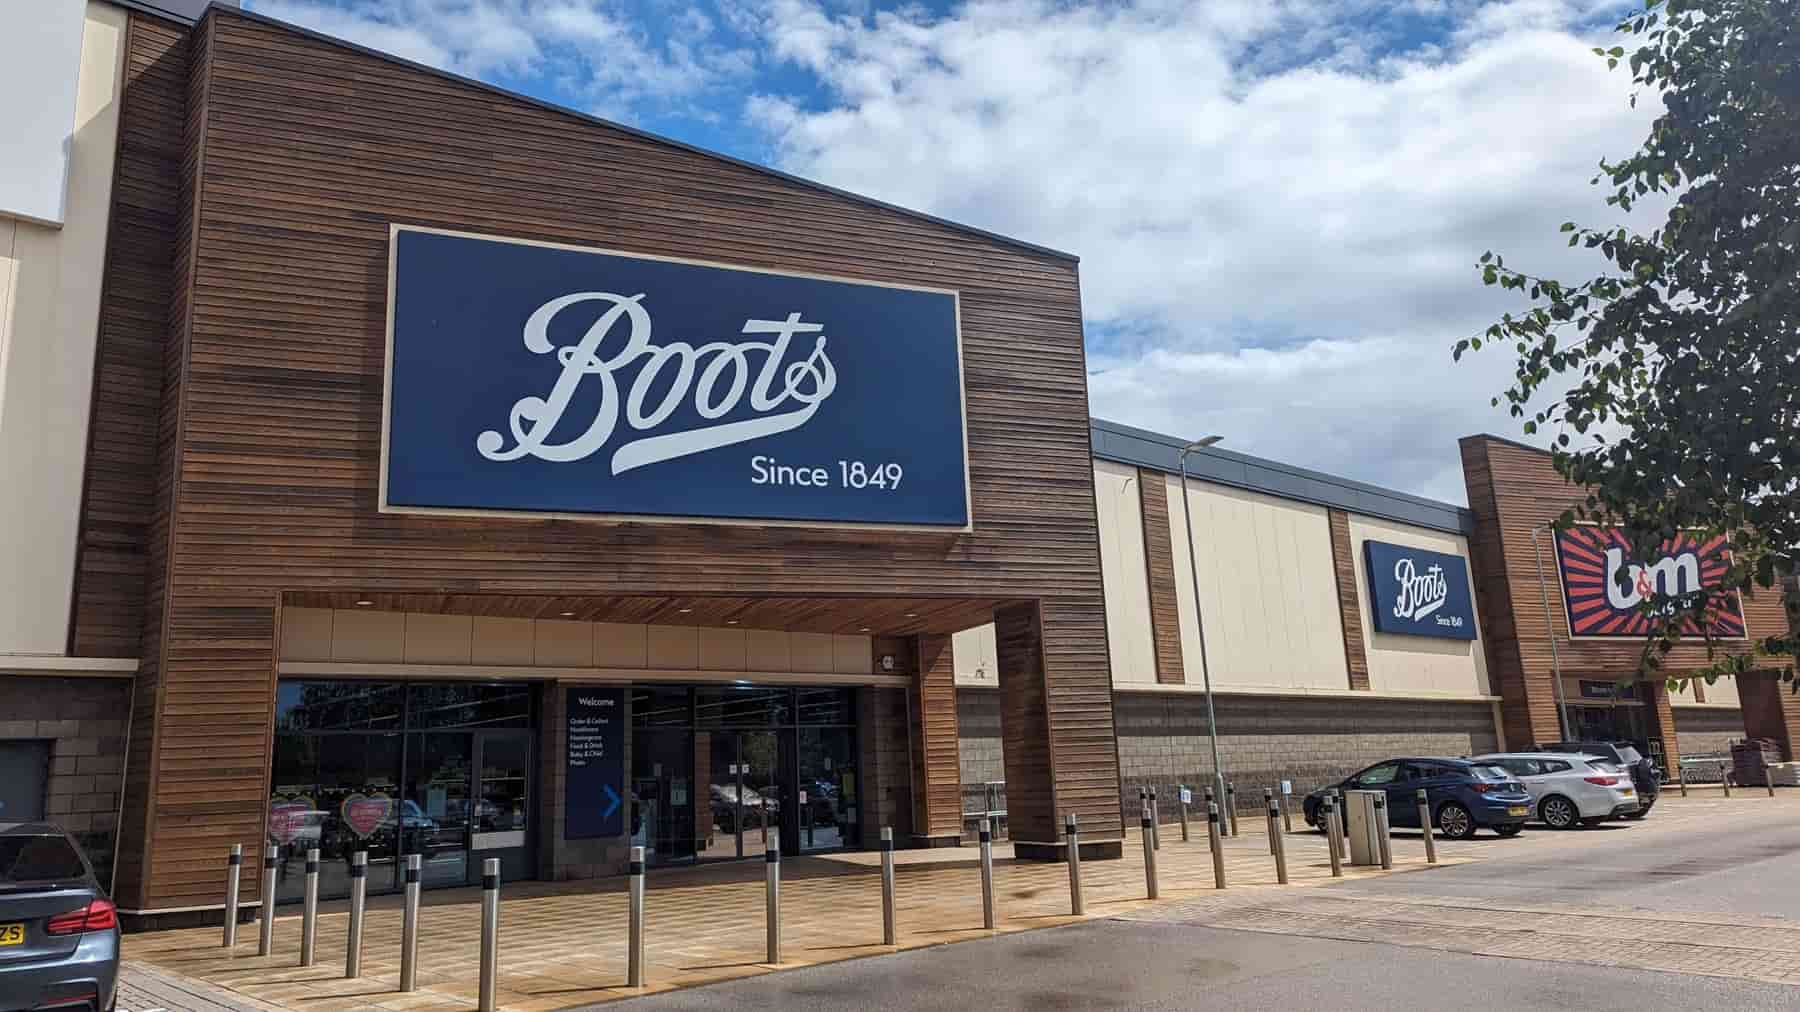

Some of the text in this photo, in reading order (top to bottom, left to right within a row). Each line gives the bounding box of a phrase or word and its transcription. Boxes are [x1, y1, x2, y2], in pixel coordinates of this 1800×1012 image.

[477, 291, 837, 476] Boots
[751, 455, 903, 490] Since 1849
[1393, 558, 1448, 622] Boots
[578, 696, 615, 707] Welcome
